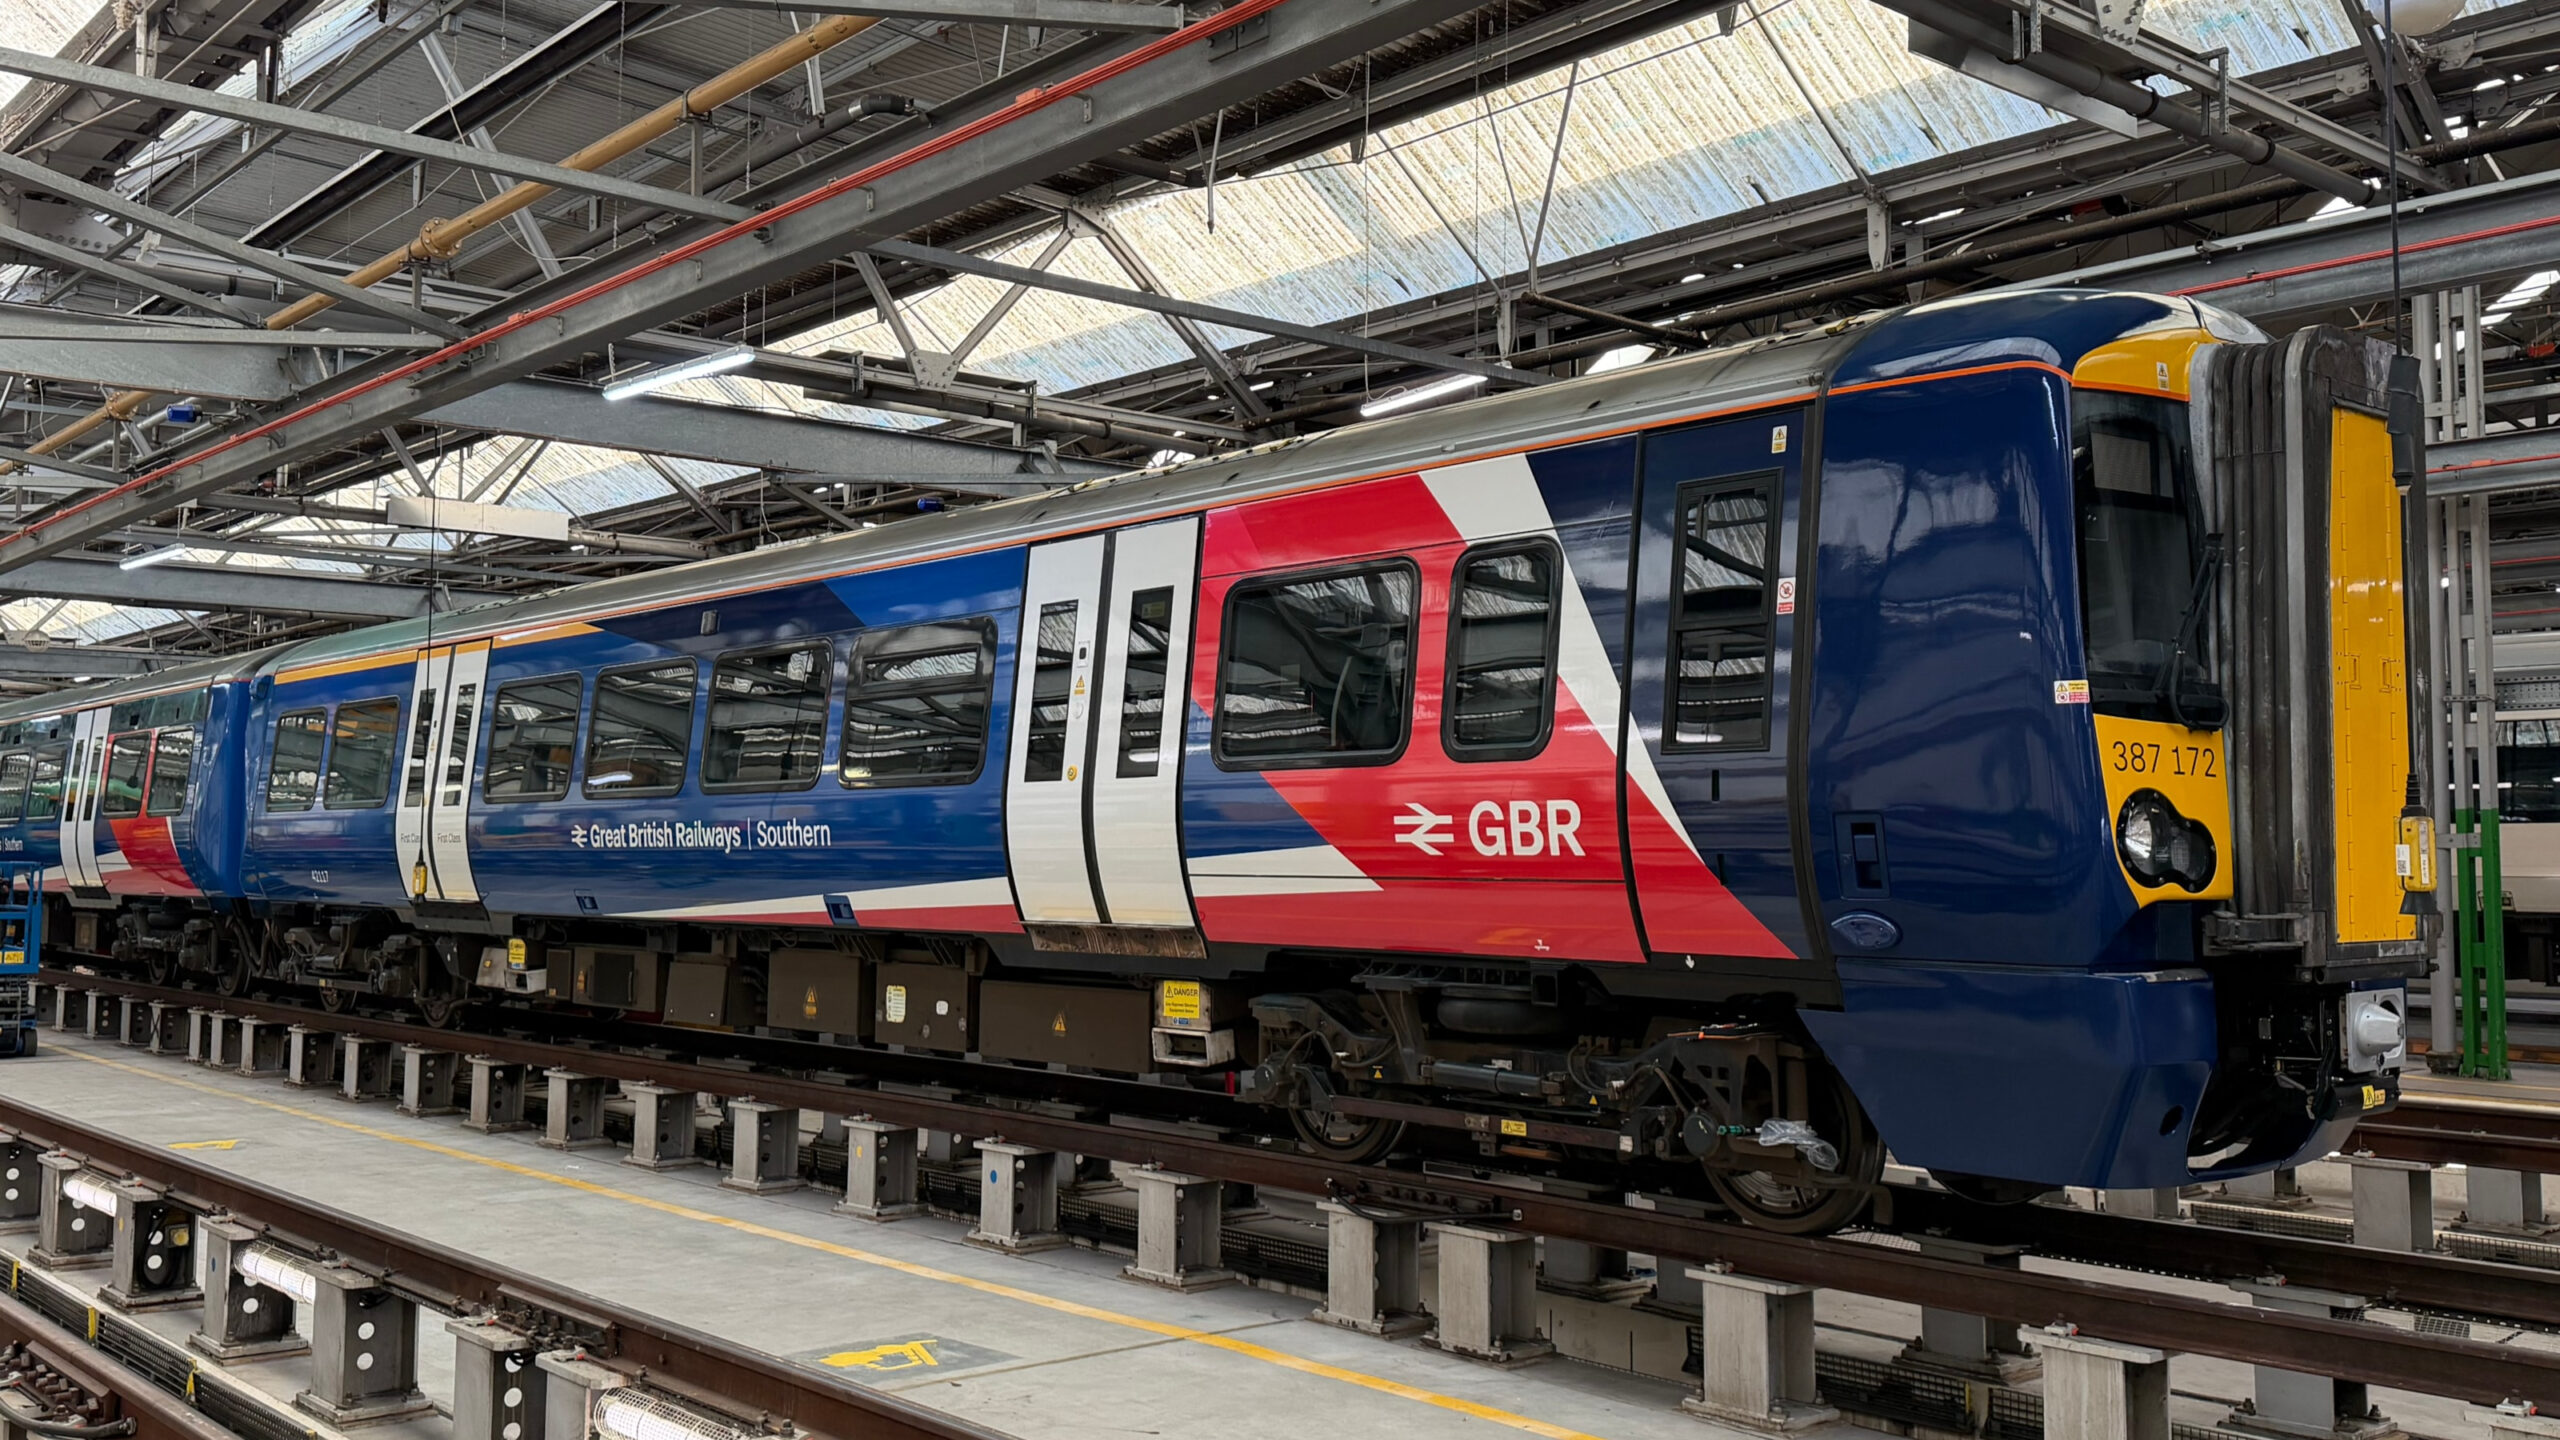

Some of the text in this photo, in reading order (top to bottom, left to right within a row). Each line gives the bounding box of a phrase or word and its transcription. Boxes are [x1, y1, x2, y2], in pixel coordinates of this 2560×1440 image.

[2112, 740, 2217, 778] 387 172
[590, 817, 832, 854] Great British Railways Southern
[1468, 799, 1587, 857] GBR
[1174, 988, 1198, 997] DANGER
